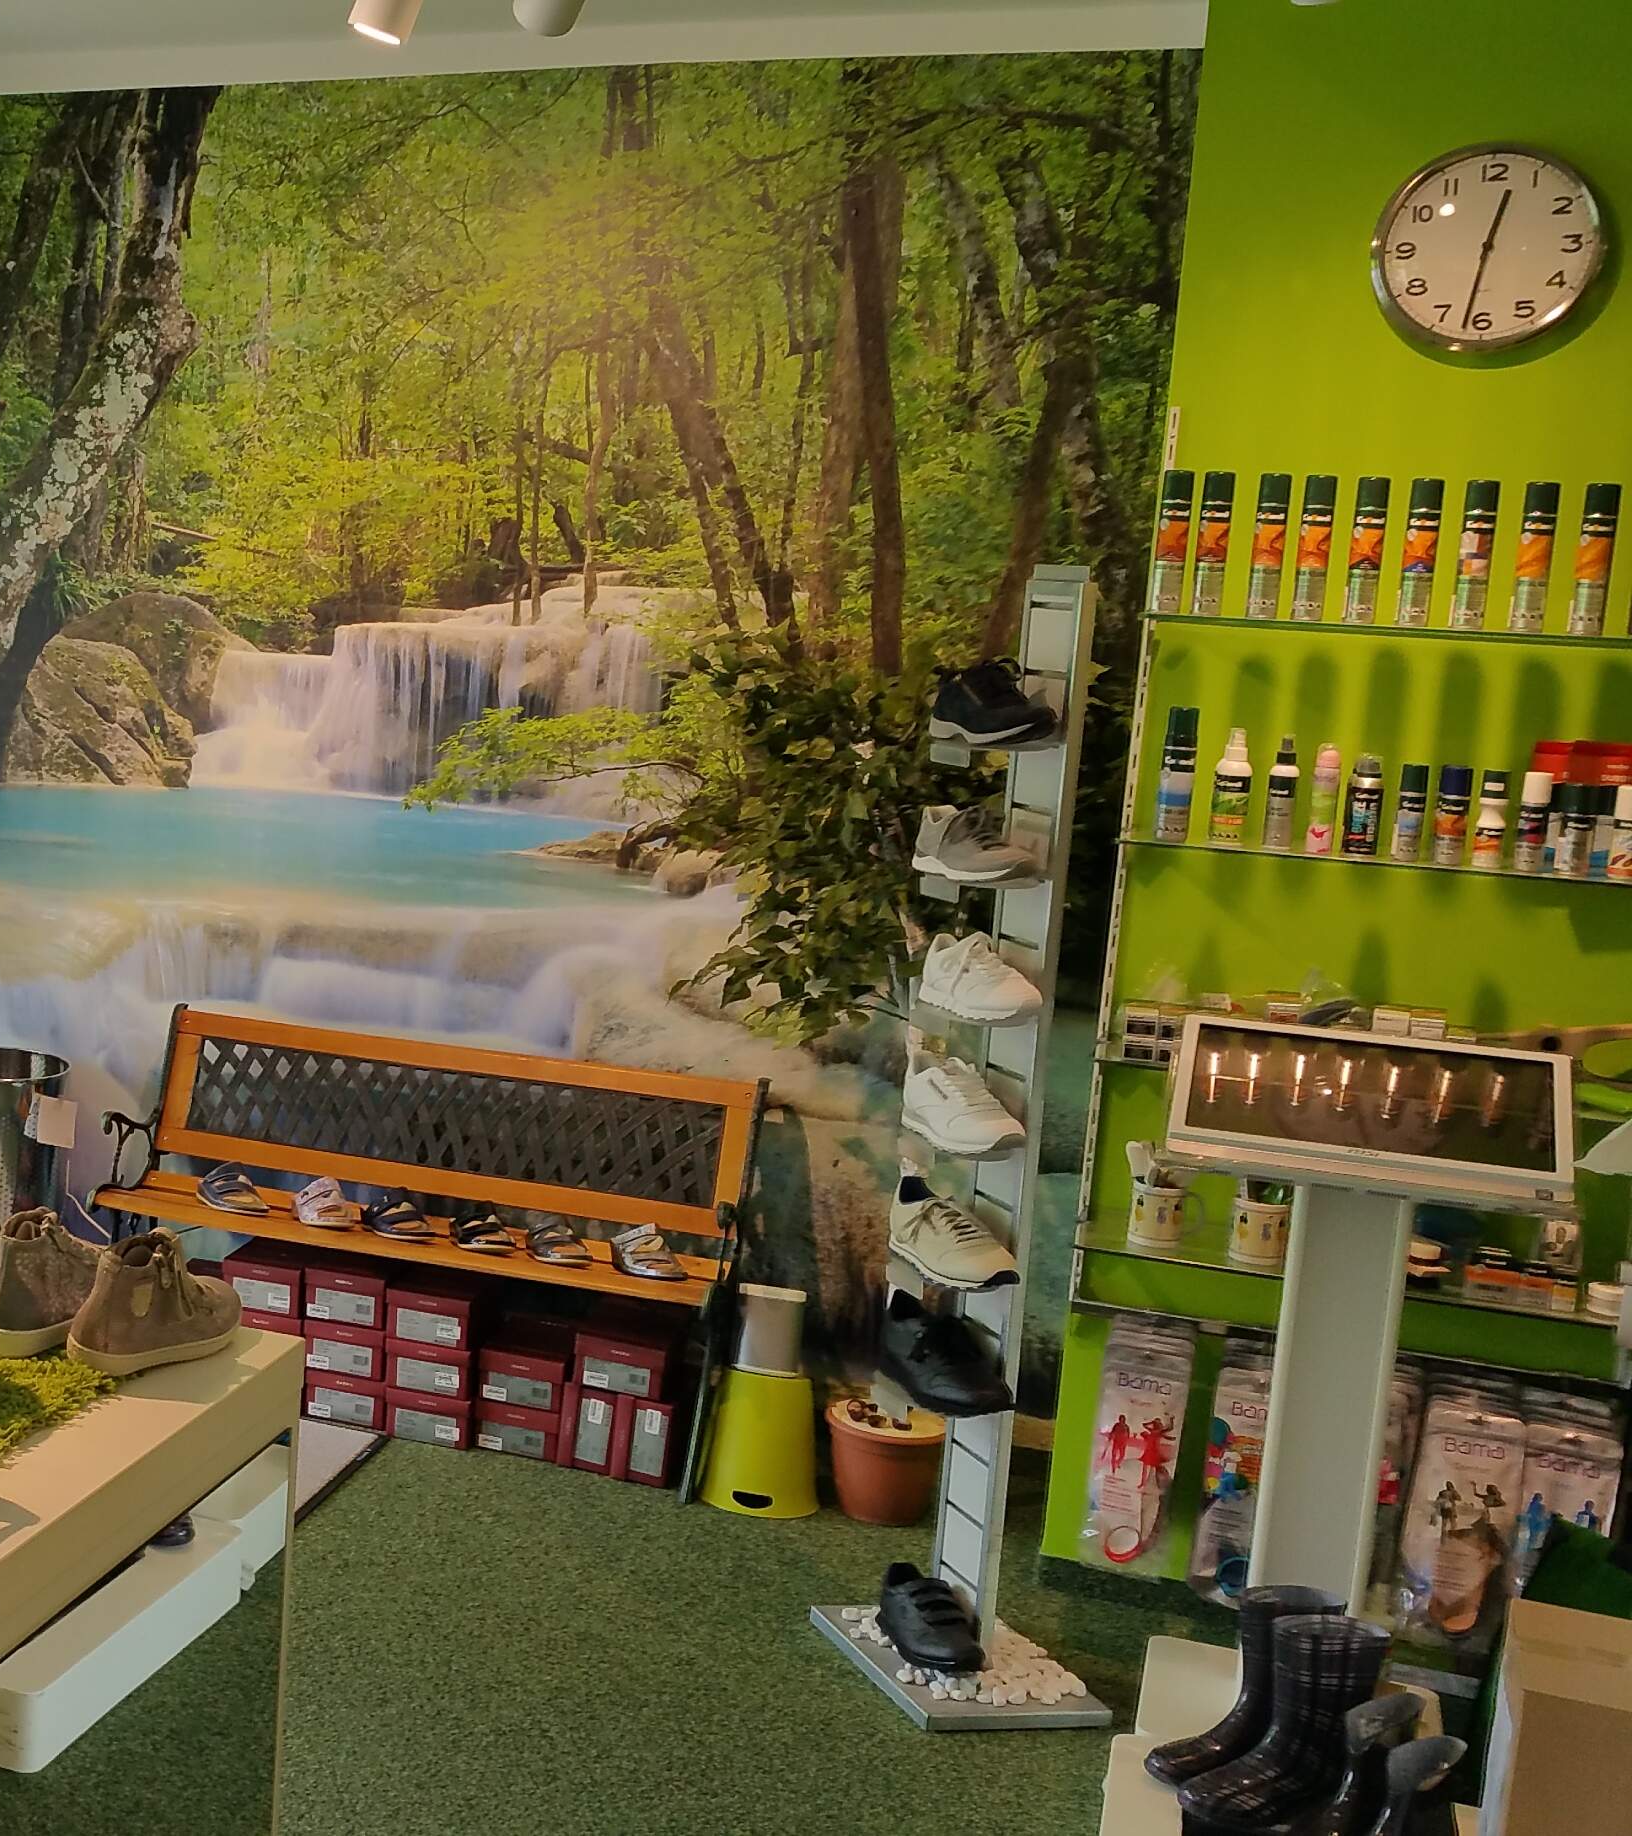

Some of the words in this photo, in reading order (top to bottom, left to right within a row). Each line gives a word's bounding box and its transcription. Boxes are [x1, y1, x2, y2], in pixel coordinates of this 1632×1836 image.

[1481, 163, 1510, 183] 12
[1532, 170, 1539, 188] 1
[1443, 178, 1459, 196] 11
[1412, 205, 1434, 223] 10
[1552, 196, 1574, 215] 2
[1395, 242, 1416, 260] 9
[1561, 233, 1583, 253] 3
[1405, 278, 1428, 296] 8
[1545, 270, 1567, 289] 4
[1434, 304, 1452, 323] 7
[1514, 300, 1536, 318] 5
[1471, 312, 1493, 331] 6
[1117, 1372, 1173, 1395] Bama
[1442, 1437, 1505, 1460] Bama
